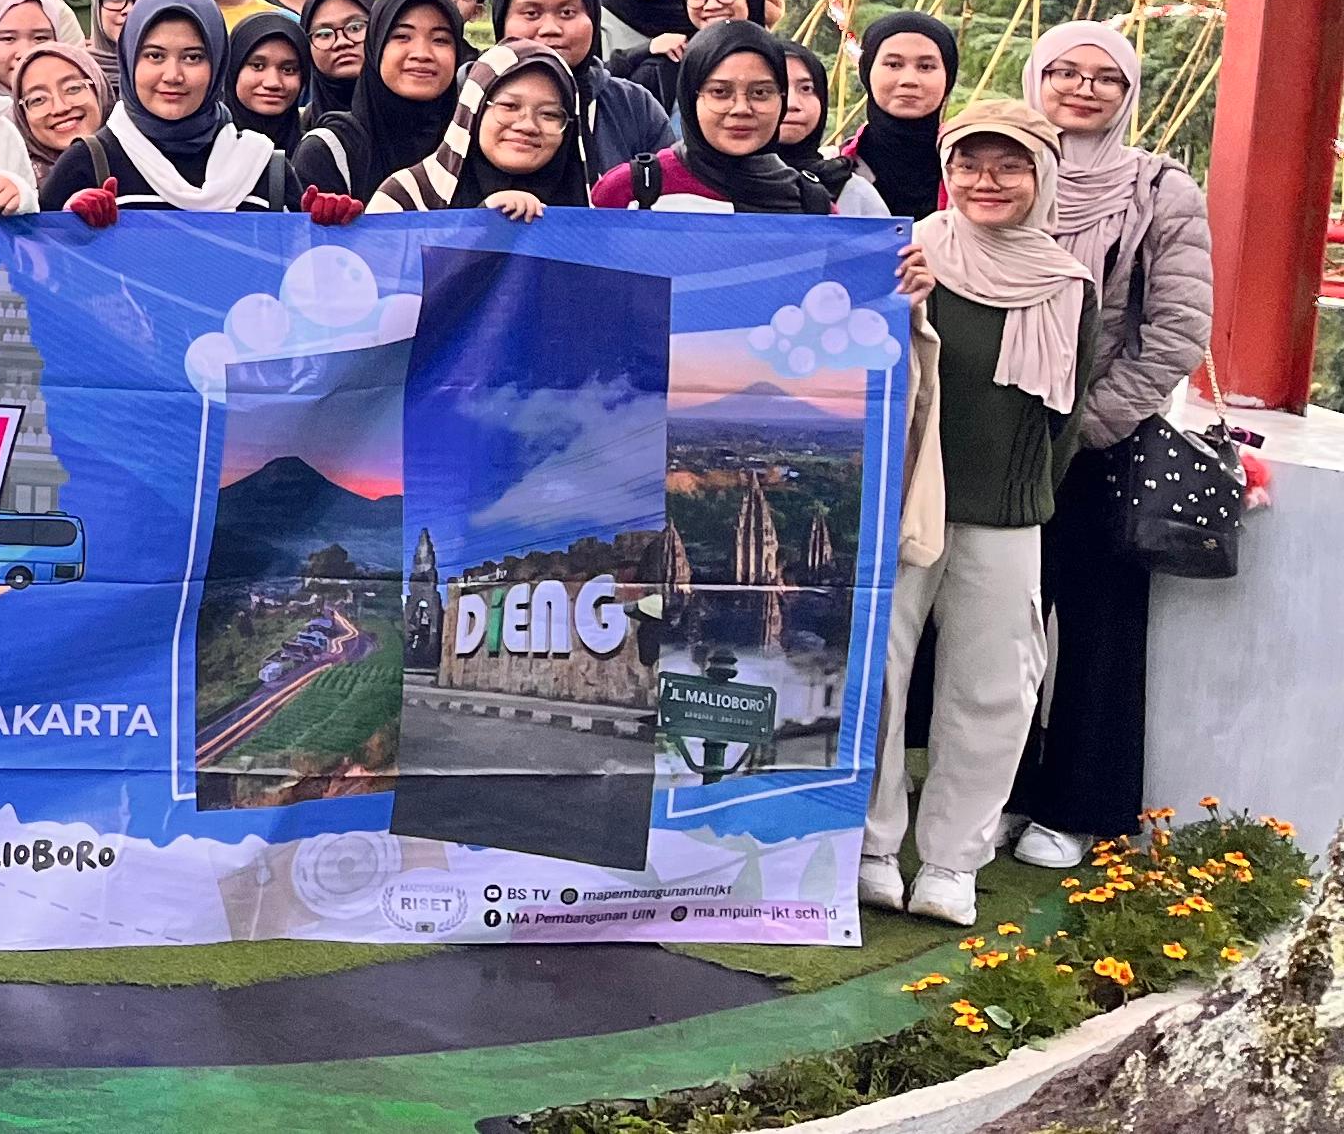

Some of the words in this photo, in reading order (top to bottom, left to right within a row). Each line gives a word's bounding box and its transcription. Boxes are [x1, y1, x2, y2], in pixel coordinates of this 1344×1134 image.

[507, 888, 527, 900] BS
[532, 888, 551, 901] TV
[401, 897, 452, 912] RISET
[506, 912, 529, 924] MA
[535, 911, 627, 925] Pembangunan
[632, 909, 656, 920] UIN
